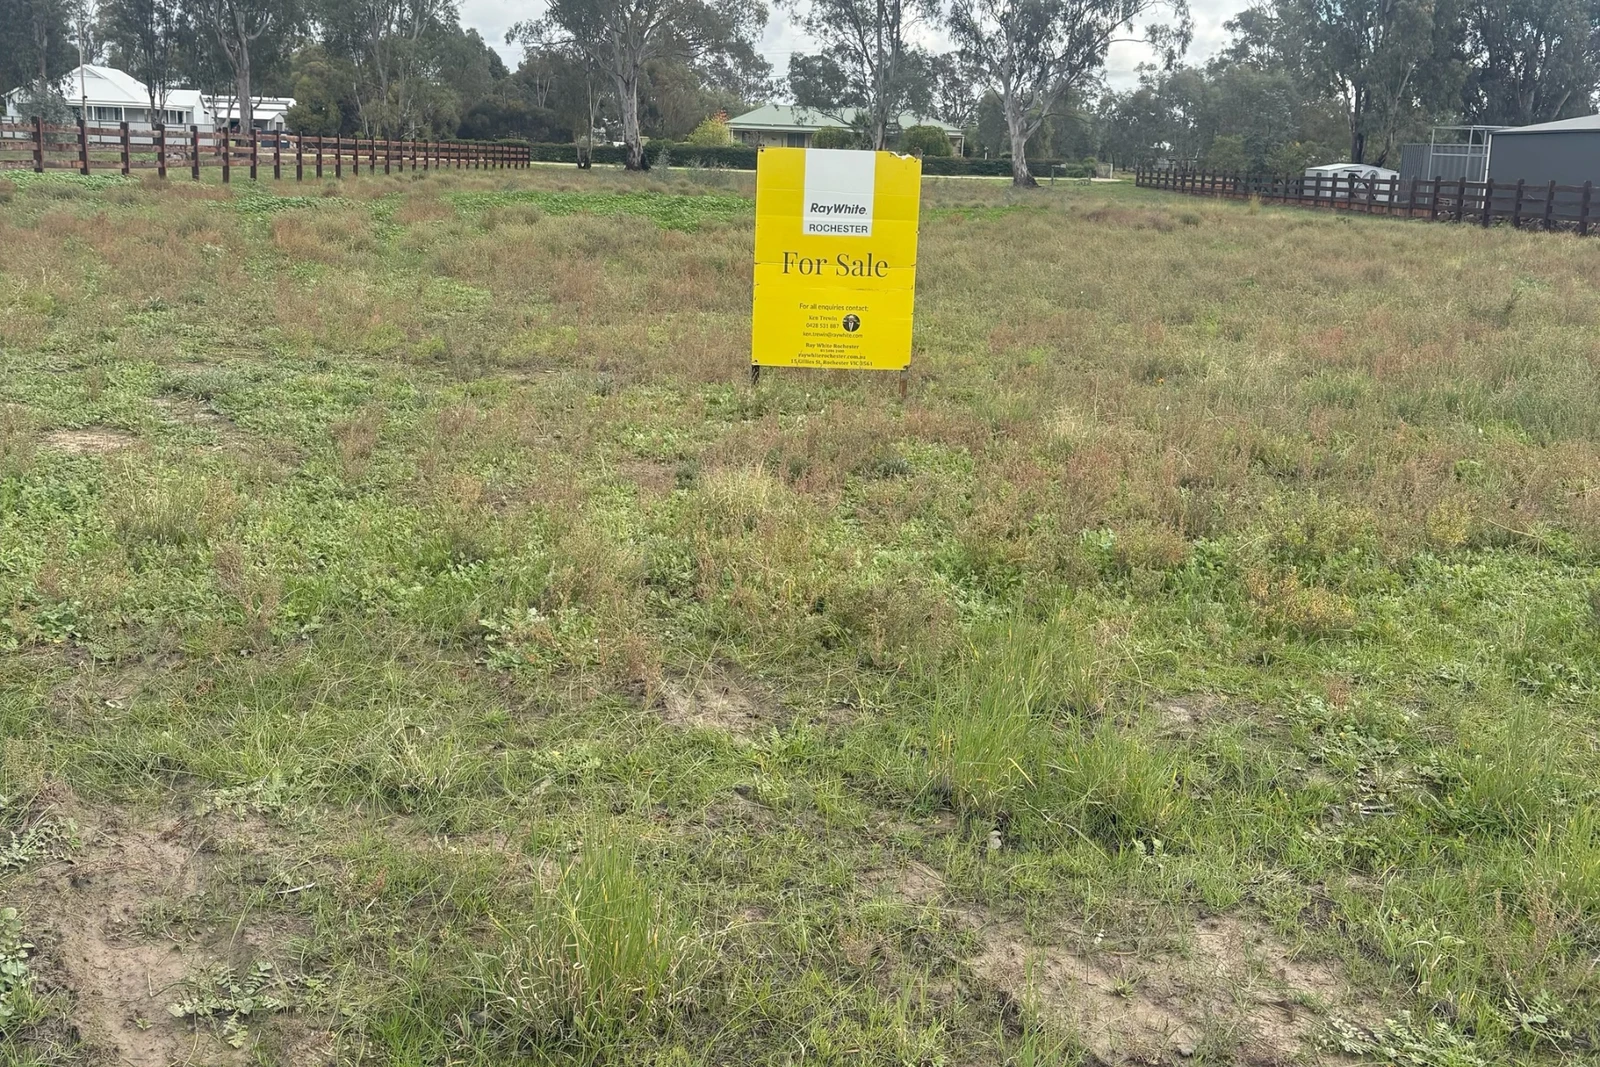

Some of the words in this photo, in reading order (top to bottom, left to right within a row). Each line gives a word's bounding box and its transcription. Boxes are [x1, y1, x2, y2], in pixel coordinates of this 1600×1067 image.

[810, 202, 867, 216] RayWhite
[808, 223, 869, 234] ROCHESTER
[782, 251, 828, 276] For
[835, 252, 889, 278] Sale
[818, 303, 845, 311] enquiries
[797, 352, 867, 360] raywhiterochester.com.au
